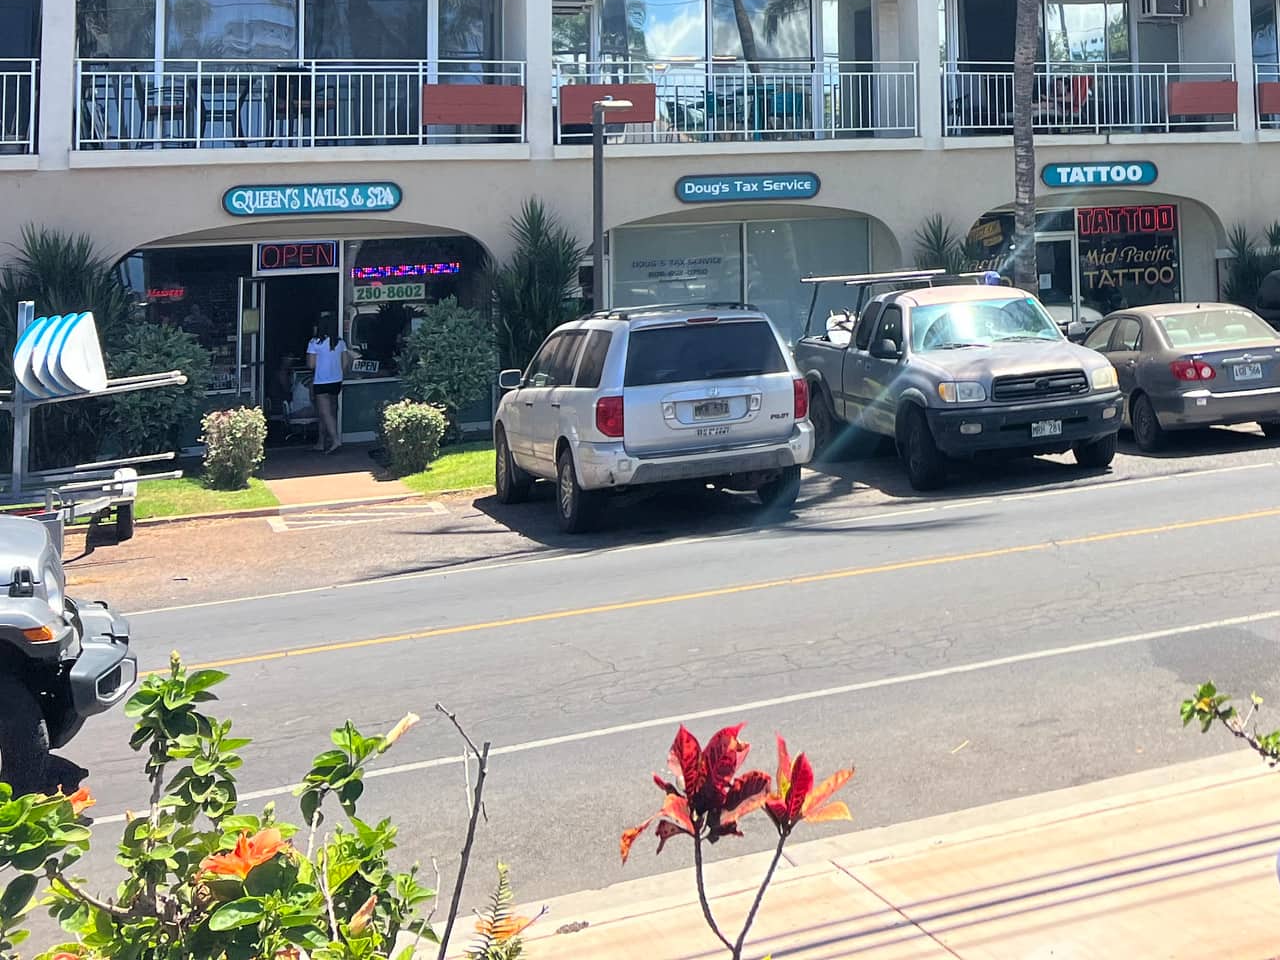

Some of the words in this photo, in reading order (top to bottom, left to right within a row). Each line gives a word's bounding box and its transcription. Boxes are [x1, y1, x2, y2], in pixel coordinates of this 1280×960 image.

[1057, 165, 1143, 183] TATTOO
[684, 182, 730, 195] Doug's
[734, 181, 758, 192] Tax
[763, 179, 811, 191] Service
[232, 188, 301, 213] QUEEN'S
[304, 187, 349, 208] NAILS
[351, 188, 364, 206] &
[367, 186, 395, 207] SPA
[1078, 205, 1174, 234] TATTOO
[262, 243, 333, 268] OPEN
[1087, 247, 1118, 265] Mid
[1120, 244, 1173, 264] Pacific
[1083, 266, 1174, 288] TATTOO
